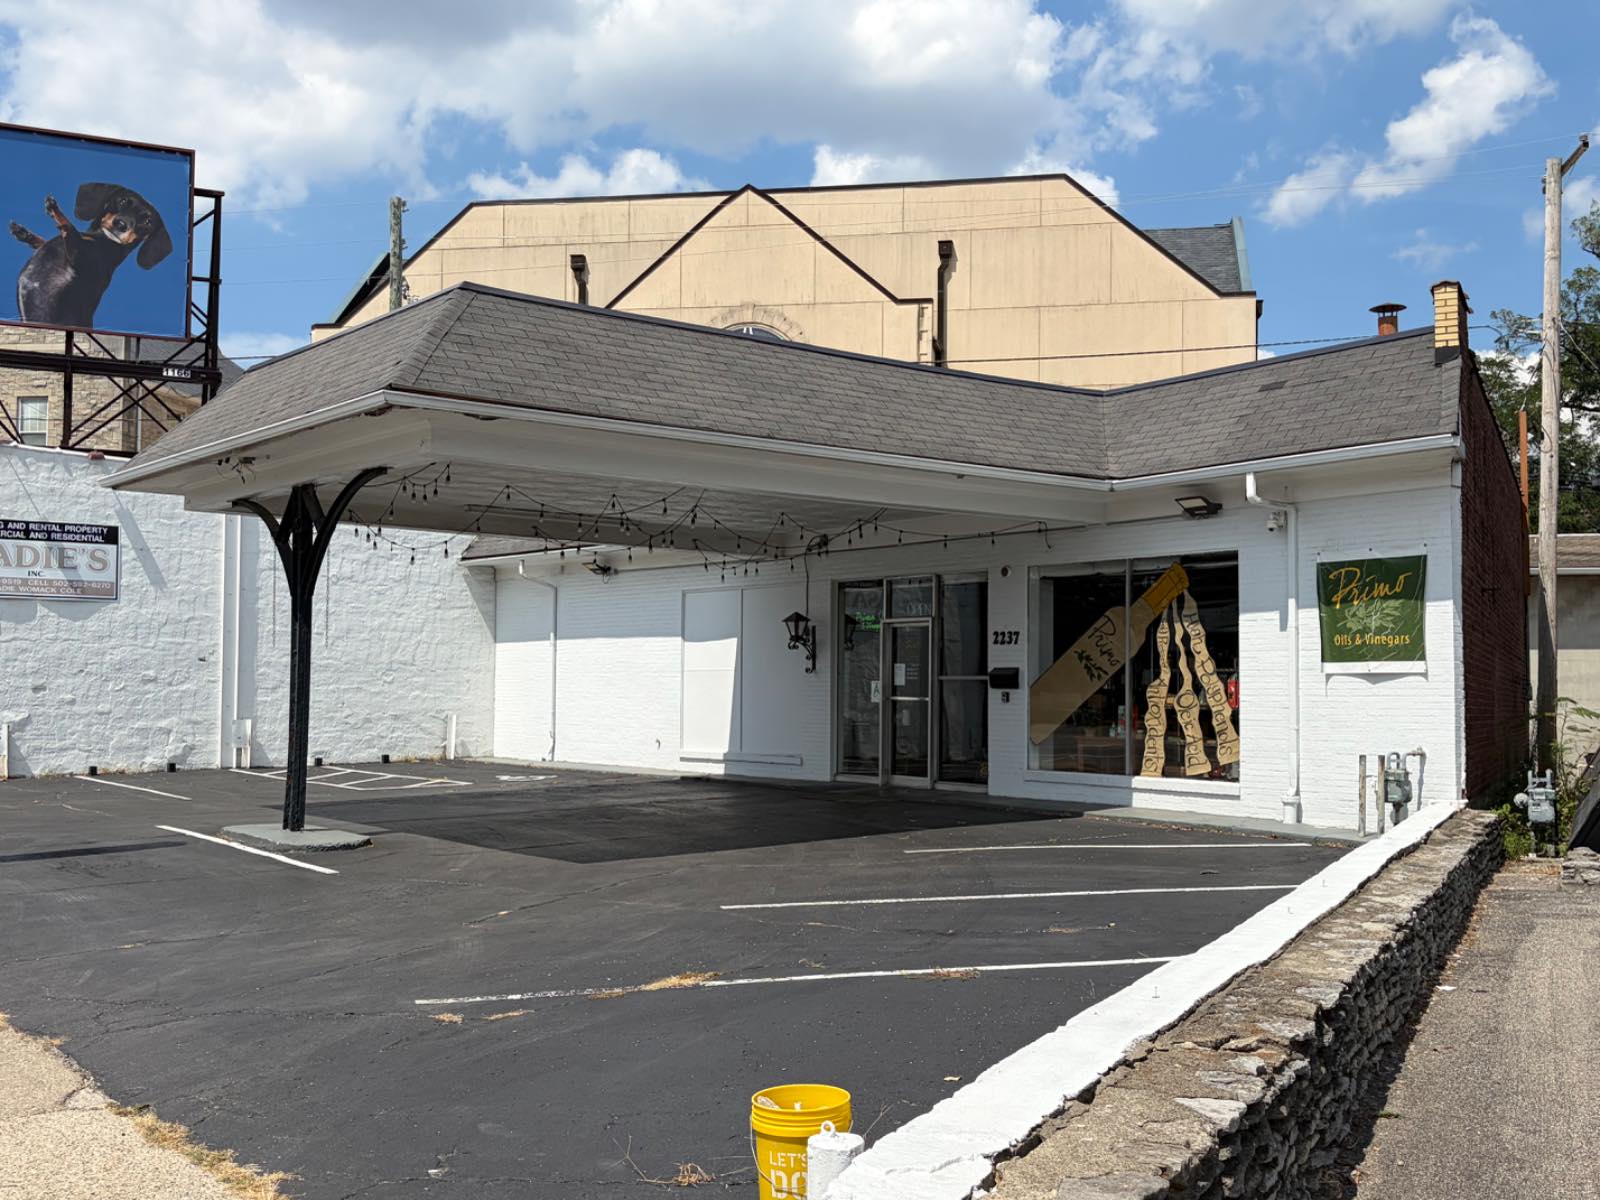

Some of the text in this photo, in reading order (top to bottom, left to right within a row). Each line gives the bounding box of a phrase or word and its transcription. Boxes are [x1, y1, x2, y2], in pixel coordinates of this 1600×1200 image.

[7, 522, 26, 530] AND
[29, 523, 61, 532] RENTAL
[65, 525, 108, 534] PROPERTY
[29, 532, 48, 540] AND
[51, 533, 104, 543] RESIDENTIAL
[19, 586, 57, 594] WOMACK
[1329, 567, 1412, 609] Primo
[992, 631, 1020, 645] 2237
[1334, 634, 1352, 646] Oils
[1364, 633, 1410, 647] Vinegars
[1200, 657, 1238, 756] Polyphenols
[1177, 689, 1208, 768] Oleic Acid
